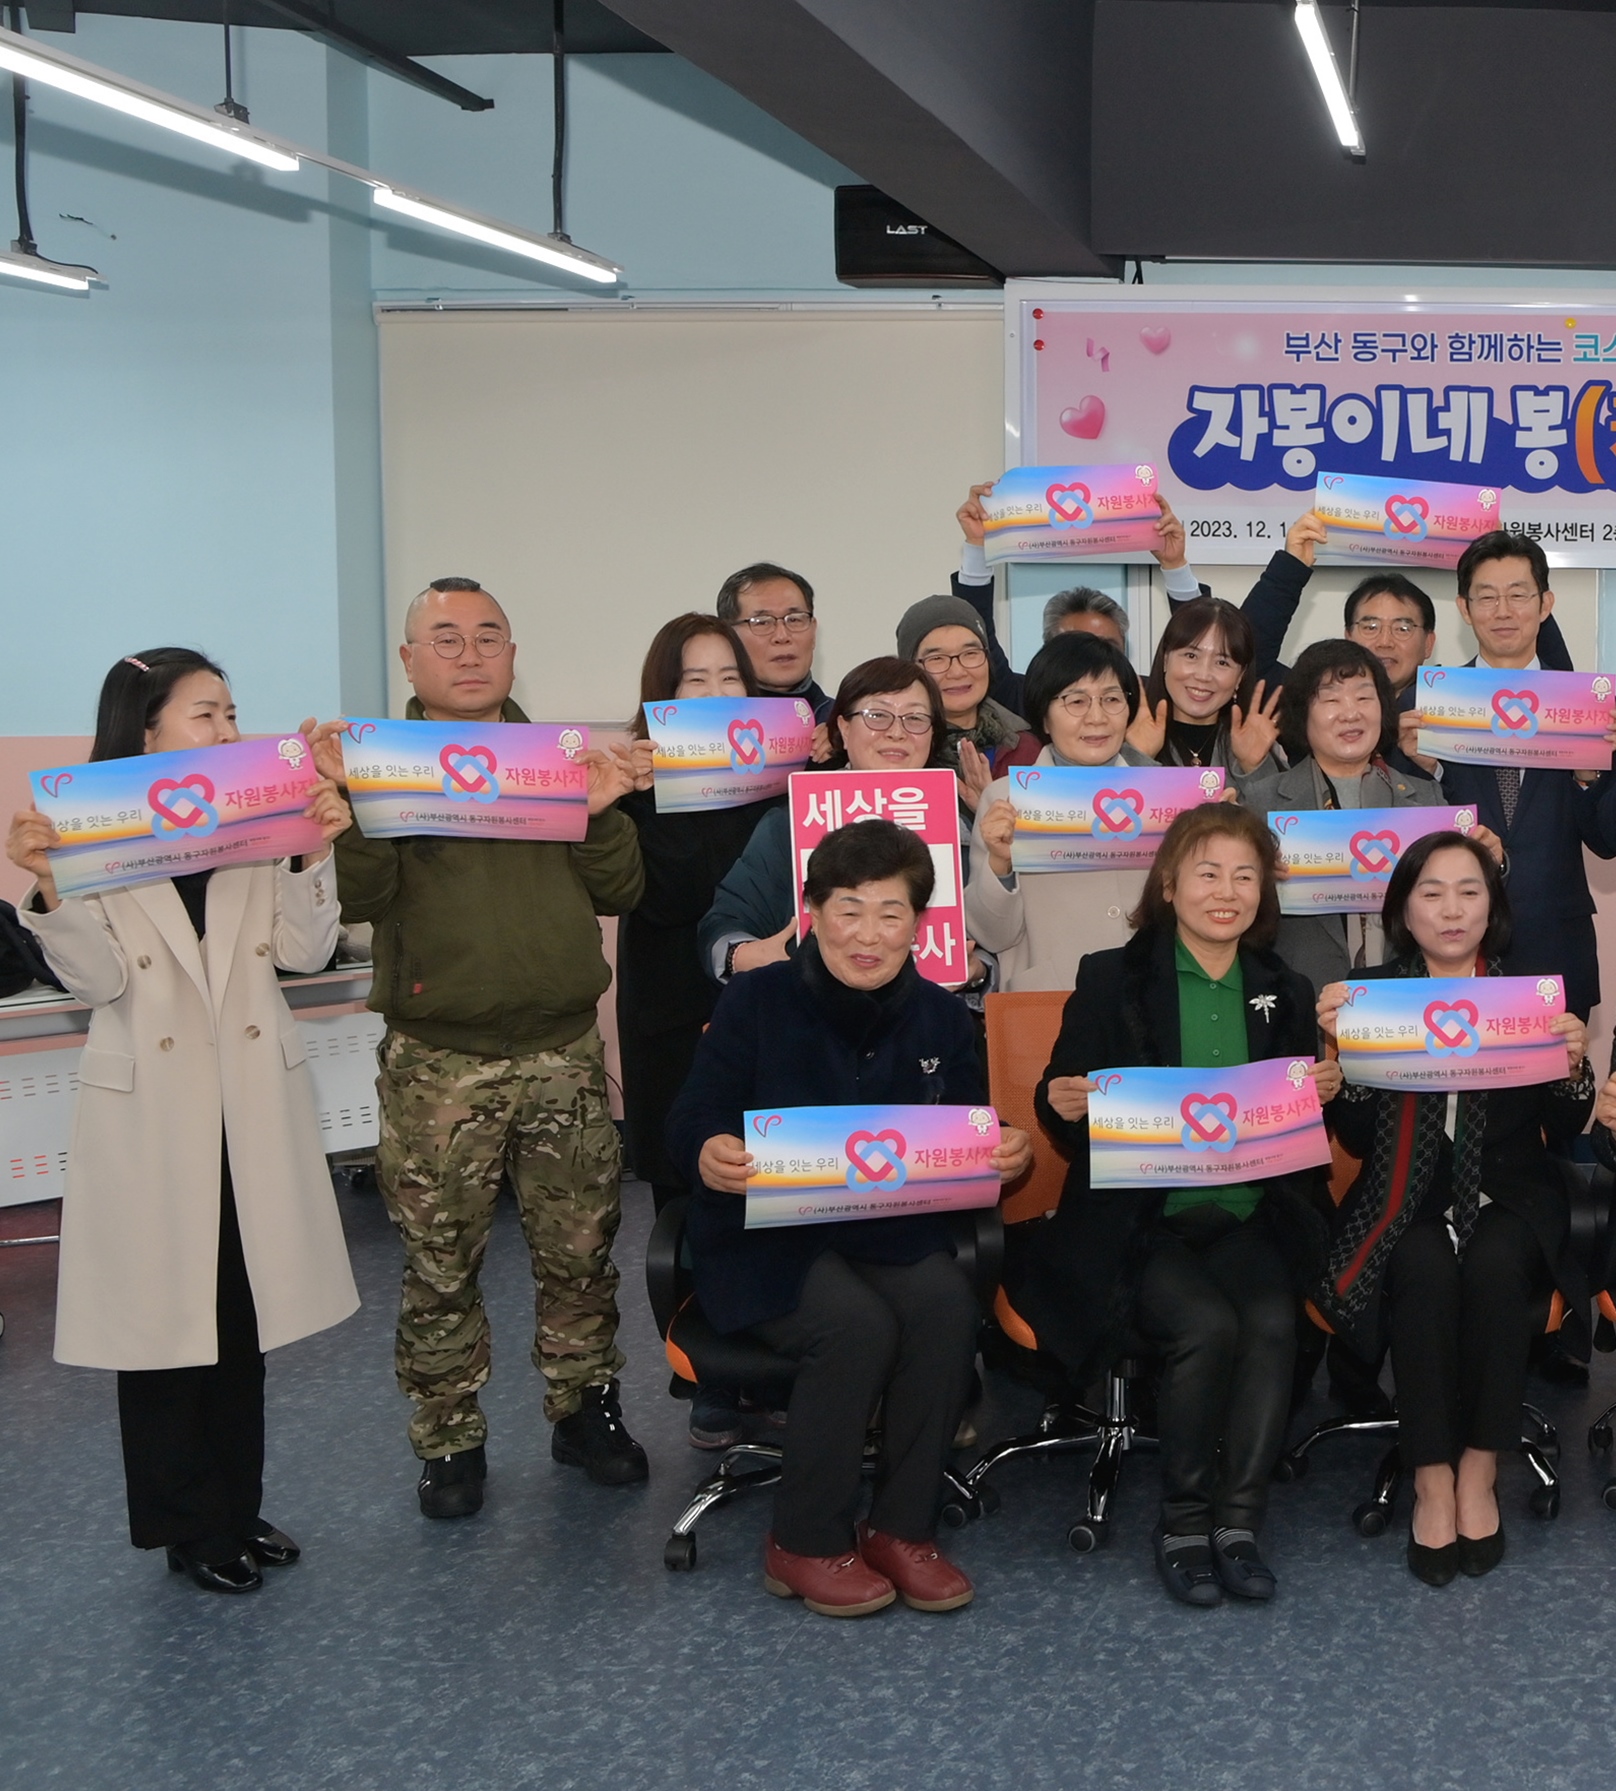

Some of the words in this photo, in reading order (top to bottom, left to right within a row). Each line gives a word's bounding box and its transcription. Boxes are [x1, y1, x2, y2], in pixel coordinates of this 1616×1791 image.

[887, 225, 928, 235] LAST
[1285, 332, 1342, 362] 부산
[1351, 332, 1438, 362] 동구와
[1448, 332, 1562, 362] 함께하는
[1192, 389, 1488, 478] 자봉이네
[1006, 506, 1022, 517] 잇는
[1026, 504, 1043, 513] 우리
[1345, 508, 1361, 519] 잇는
[1364, 511, 1379, 520] 우리
[1190, 520, 1237, 538] 2023.
[1246, 521, 1271, 539] 12.
[1448, 707, 1465, 717] 잇는
[1469, 707, 1485, 717] 우리
[688, 744, 705, 756] 잇는
[709, 742, 725, 754] 우리
[349, 766, 381, 779] 세상을
[386, 765, 408, 778] 잇는
[412, 766, 434, 778] 우리
[505, 767, 584, 789] 자원봉사자
[50, 819, 82, 832] 상을
[88, 814, 112, 829] 잇는
[117, 810, 142, 824] 우리
[1043, 810, 1063, 821] 잇는
[1068, 810, 1086, 821] 우리
[1282, 854, 1300, 864] 상을
[1304, 853, 1322, 864] 잇는
[1325, 852, 1344, 863] 우리
[1340, 1028, 1371, 1040] 세상을
[1375, 1027, 1394, 1039] 잇는
[1398, 1025, 1418, 1036] 우리
[1486, 1016, 1554, 1035] 자원봉사
[1093, 1117, 1124, 1129] 세상을
[1128, 1117, 1149, 1129] 잇는
[1153, 1116, 1174, 1128] 우리
[1243, 1096, 1317, 1127] 자원봉사자
[790, 1160, 811, 1172] 잇는
[816, 1157, 838, 1170] 우리
